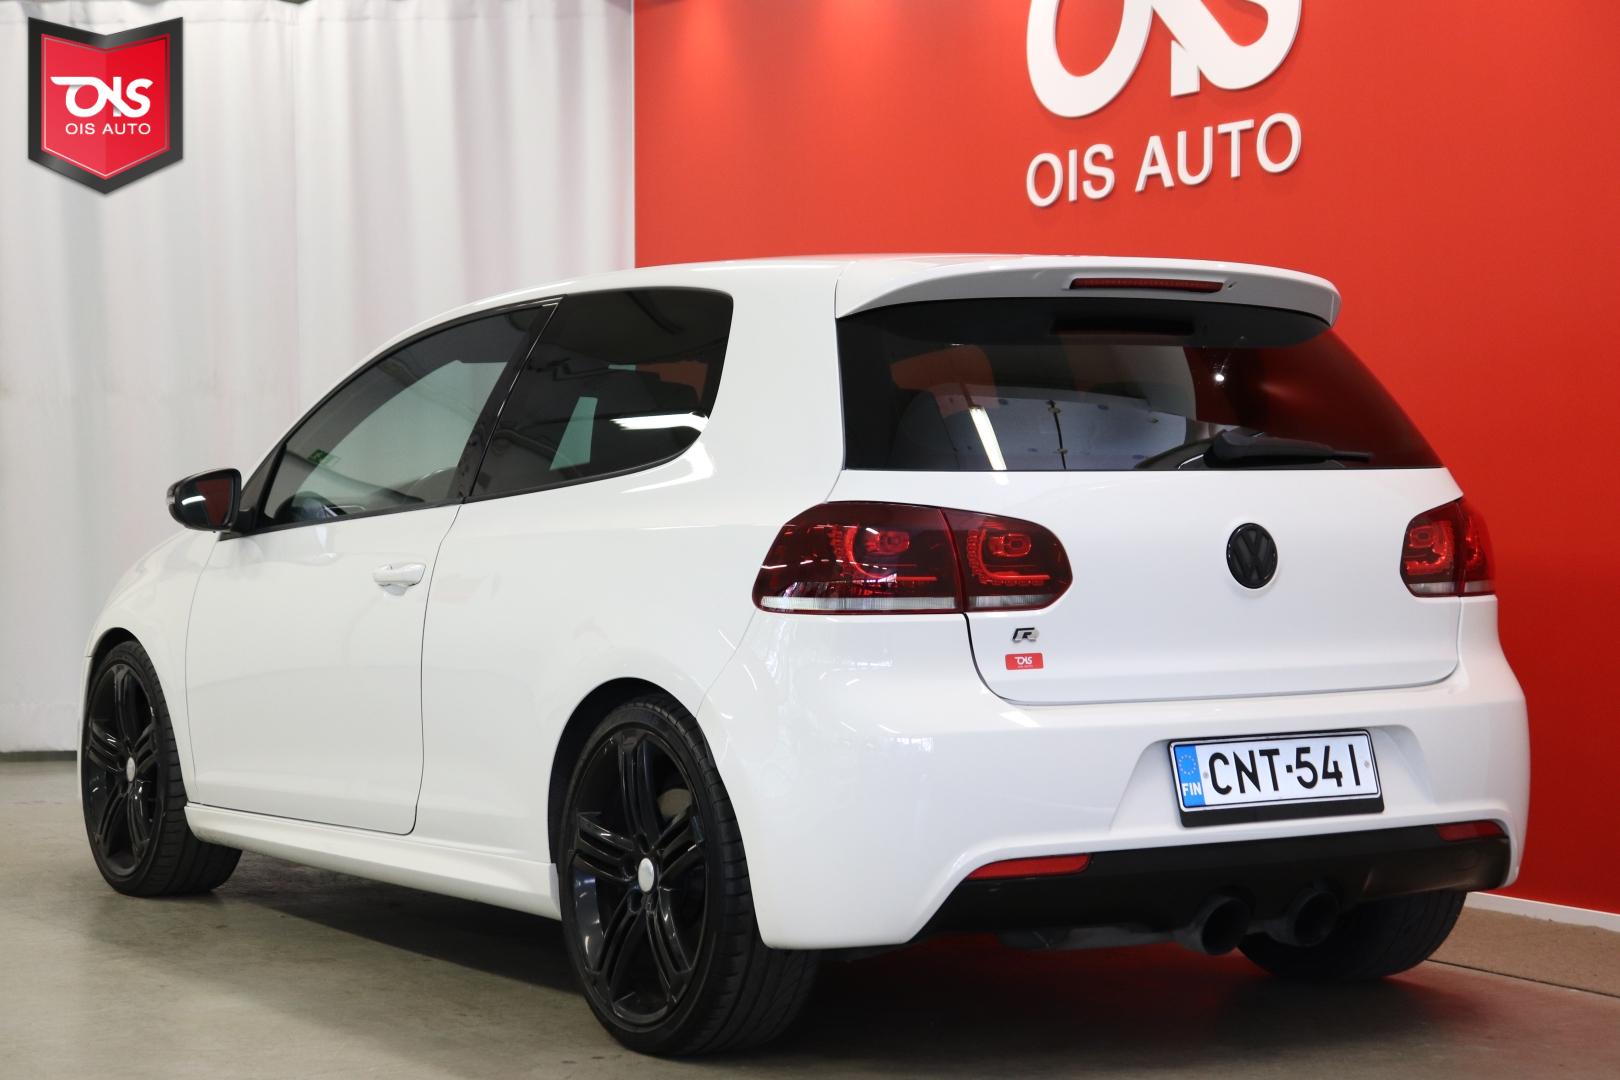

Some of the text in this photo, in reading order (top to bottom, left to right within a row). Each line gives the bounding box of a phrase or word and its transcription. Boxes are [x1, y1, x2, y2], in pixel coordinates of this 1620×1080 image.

[1026, 112, 1301, 207] OIS AUTO
[1182, 781, 1202, 797] FIN
